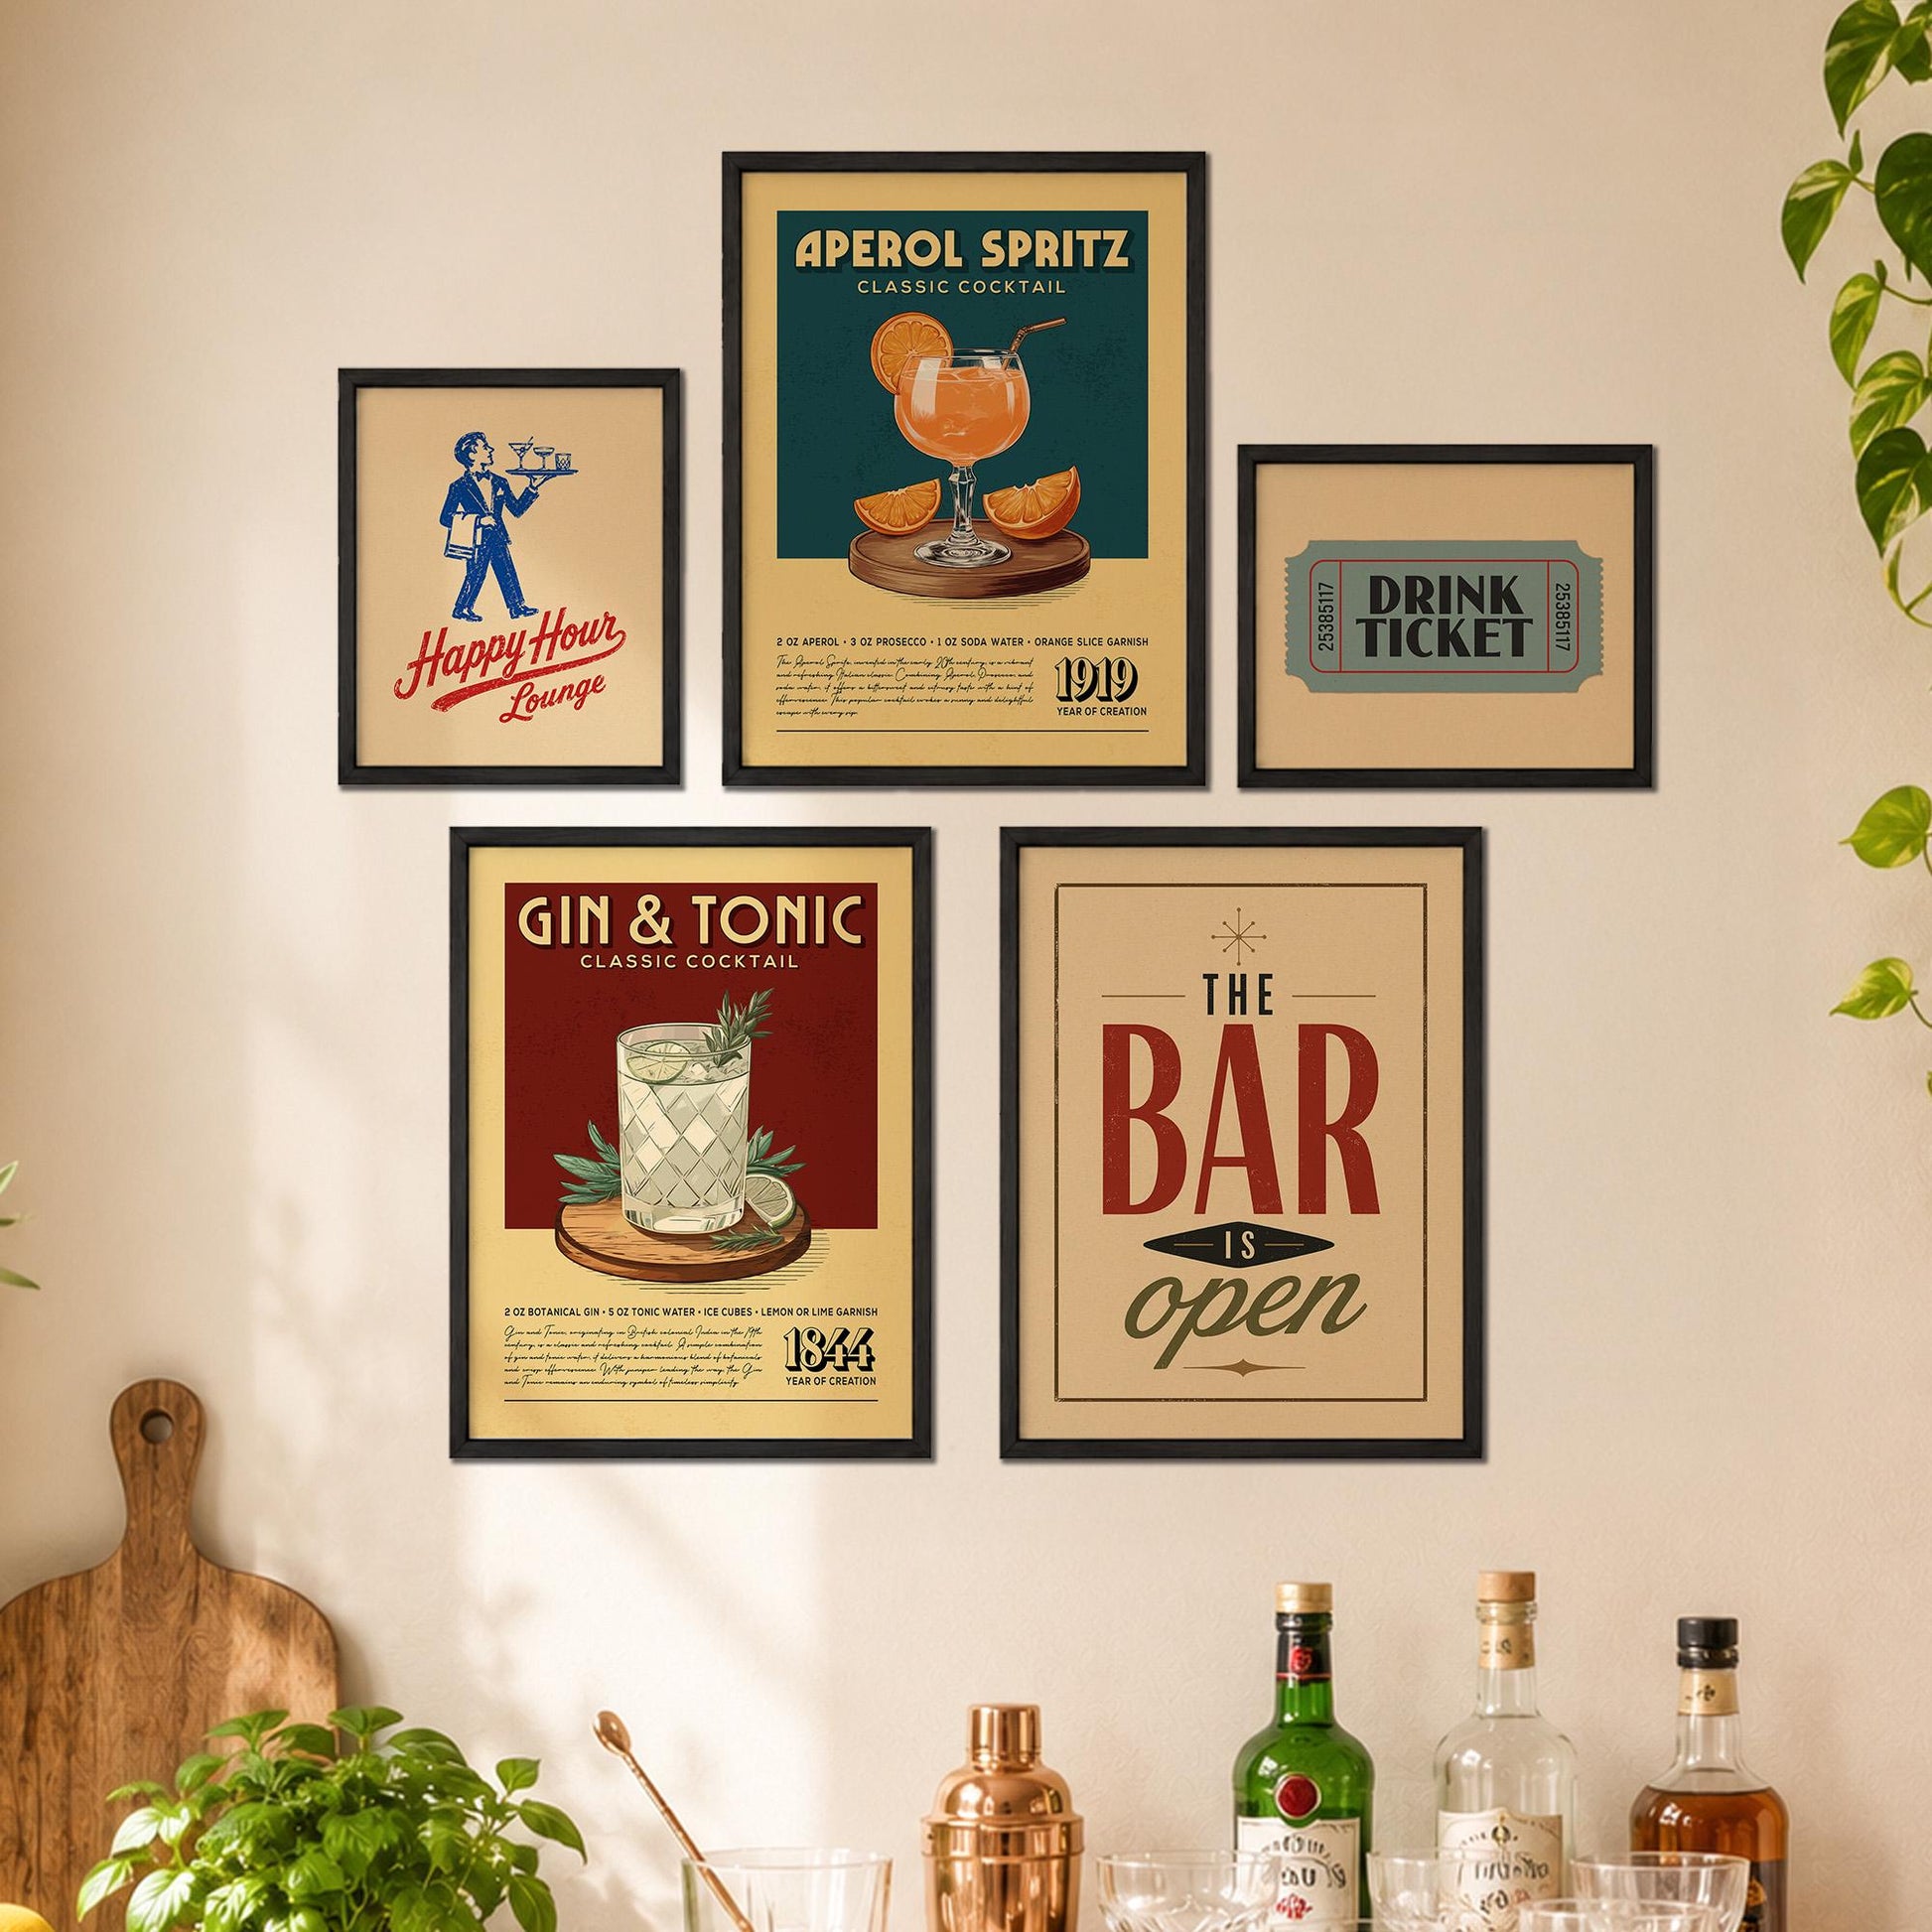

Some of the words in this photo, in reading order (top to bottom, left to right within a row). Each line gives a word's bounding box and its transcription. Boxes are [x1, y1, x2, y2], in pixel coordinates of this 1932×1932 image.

[795, 229, 963, 267] APEROL
[981, 229, 1129, 267] SPRITZ
[857, 279, 949, 295] CLASSIC
[958, 279, 1066, 295] COCKTAIL
[1369, 575, 1524, 615] DRINK
[1317, 582, 1334, 652] 25385117
[1355, 617, 1534, 658] TICKET
[1555, 583, 1571, 652] 25385117
[393, 626, 527, 700] Happy
[528, 607, 626, 665] Hour
[776, 636, 783, 647] 2
[785, 636, 799, 647] OZ
[801, 636, 840, 647] APEROL
[850, 636, 857, 647] 3
[860, 636, 873, 647] OZ
[876, 636, 927, 647] PROSECCO
[937, 636, 942, 647] 1
[944, 636, 958, 647] OZ
[960, 636, 988, 647] SODA
[990, 636, 1025, 647] WATER
[1034, 636, 1073, 647] ORANGE
[1076, 636, 1104, 647] SLICE
[1106, 636, 1149, 647] GARNISH
[498, 674, 607, 724] Lounge
[1054, 656, 1139, 703] 1919
[1056, 706, 1083, 716] YEAR
[1084, 706, 1098, 716] OF
[1099, 706, 1148, 716] CREATION
[518, 896, 609, 945] GIN
[628, 894, 673, 945] &
[691, 895, 862, 944] TONIC
[580, 954, 676, 969] CLASSIC
[686, 954, 798, 969] COCKTAIL
[1202, 973, 1274, 1016] THE
[1102, 1023, 1381, 1215] BAR
[1225, 1230, 1256, 1260] IS
[504, 1307, 511, 1316] 2
[512, 1307, 526, 1316] OZ
[527, 1307, 582, 1316] BOTANICAL
[583, 1307, 600, 1316] GIN
[608, 1307, 615, 1316] 5
[616, 1307, 629, 1316] OZ
[631, 1307, 660, 1316] TONIC
[661, 1307, 696, 1316] WATER
[703, 1307, 719, 1316] ICE
[721, 1307, 753, 1316] CUBES
[760, 1307, 794, 1316] LEMON
[795, 1307, 810, 1316] OR
[811, 1307, 834, 1316] LIME
[836, 1307, 879, 1316] GARNISH
[1124, 1273, 1368, 1370] open
[782, 1326, 877, 1373] 1844
[785, 1376, 812, 1386] YEAR
[813, 1376, 827, 1386] OF
[828, 1376, 877, 1386] CREATION
